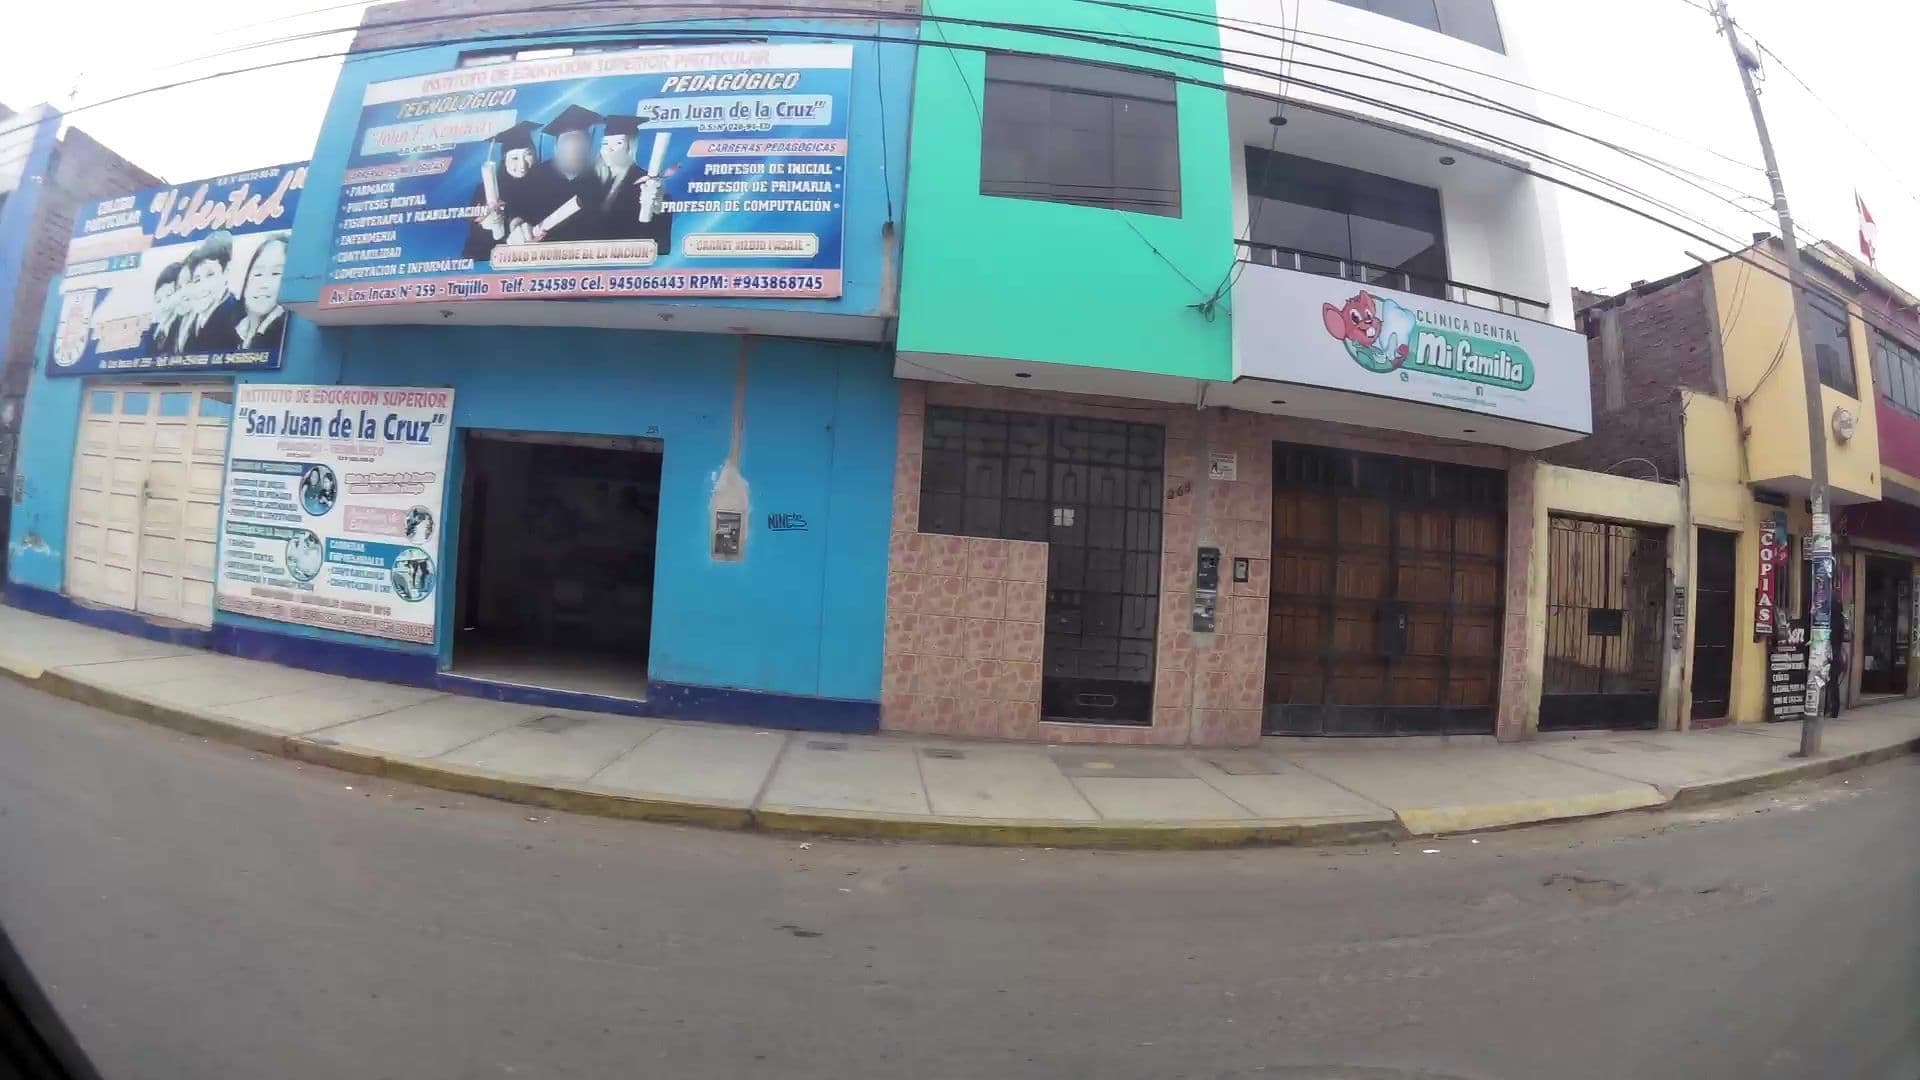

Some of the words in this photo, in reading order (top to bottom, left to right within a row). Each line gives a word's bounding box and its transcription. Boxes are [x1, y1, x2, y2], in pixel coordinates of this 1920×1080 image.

[661, 69, 801, 93] PEDAGÓGICO
[684, 102, 722, 120] Juan
[729, 101, 748, 118] de
[755, 101, 770, 118] la
[708, 142, 762, 153] CARRERAS
[704, 163, 766, 175] PROFESOR
[769, 164, 785, 174] DE
[787, 163, 833, 175] INICIAL
[687, 182, 748, 193] PROFESOR
[752, 182, 768, 192] DE
[771, 181, 832, 193] PRIMARIA
[661, 201, 721, 213] PROFESOR
[725, 200, 739, 212] DE
[743, 198, 831, 212] COMPUTACIÓN
[405, 212, 412, 224] Y
[347, 289, 365, 302] Los
[368, 287, 397, 300] Incas
[416, 284, 436, 297] 259
[447, 280, 489, 300] Trujillo
[501, 279, 524, 293] Telf.
[530, 278, 577, 292] 254589
[581, 276, 604, 290] Cel.
[609, 275, 685, 291] 945066443
[689, 275, 728, 289] RPM:
[733, 276, 823, 290] #943868745
[1473, 321, 1520, 343] DENTAL
[1416, 331, 1452, 369] Mi
[1456, 338, 1524, 384] familia
[240, 389, 292, 403] INSTITUTO
[296, 389, 310, 403] DE
[382, 391, 448, 409] SUPERIOR
[280, 409, 322, 437] Juan
[328, 408, 351, 438] de
[357, 409, 377, 440] la
[1758, 532, 1774, 622] COPIAS
